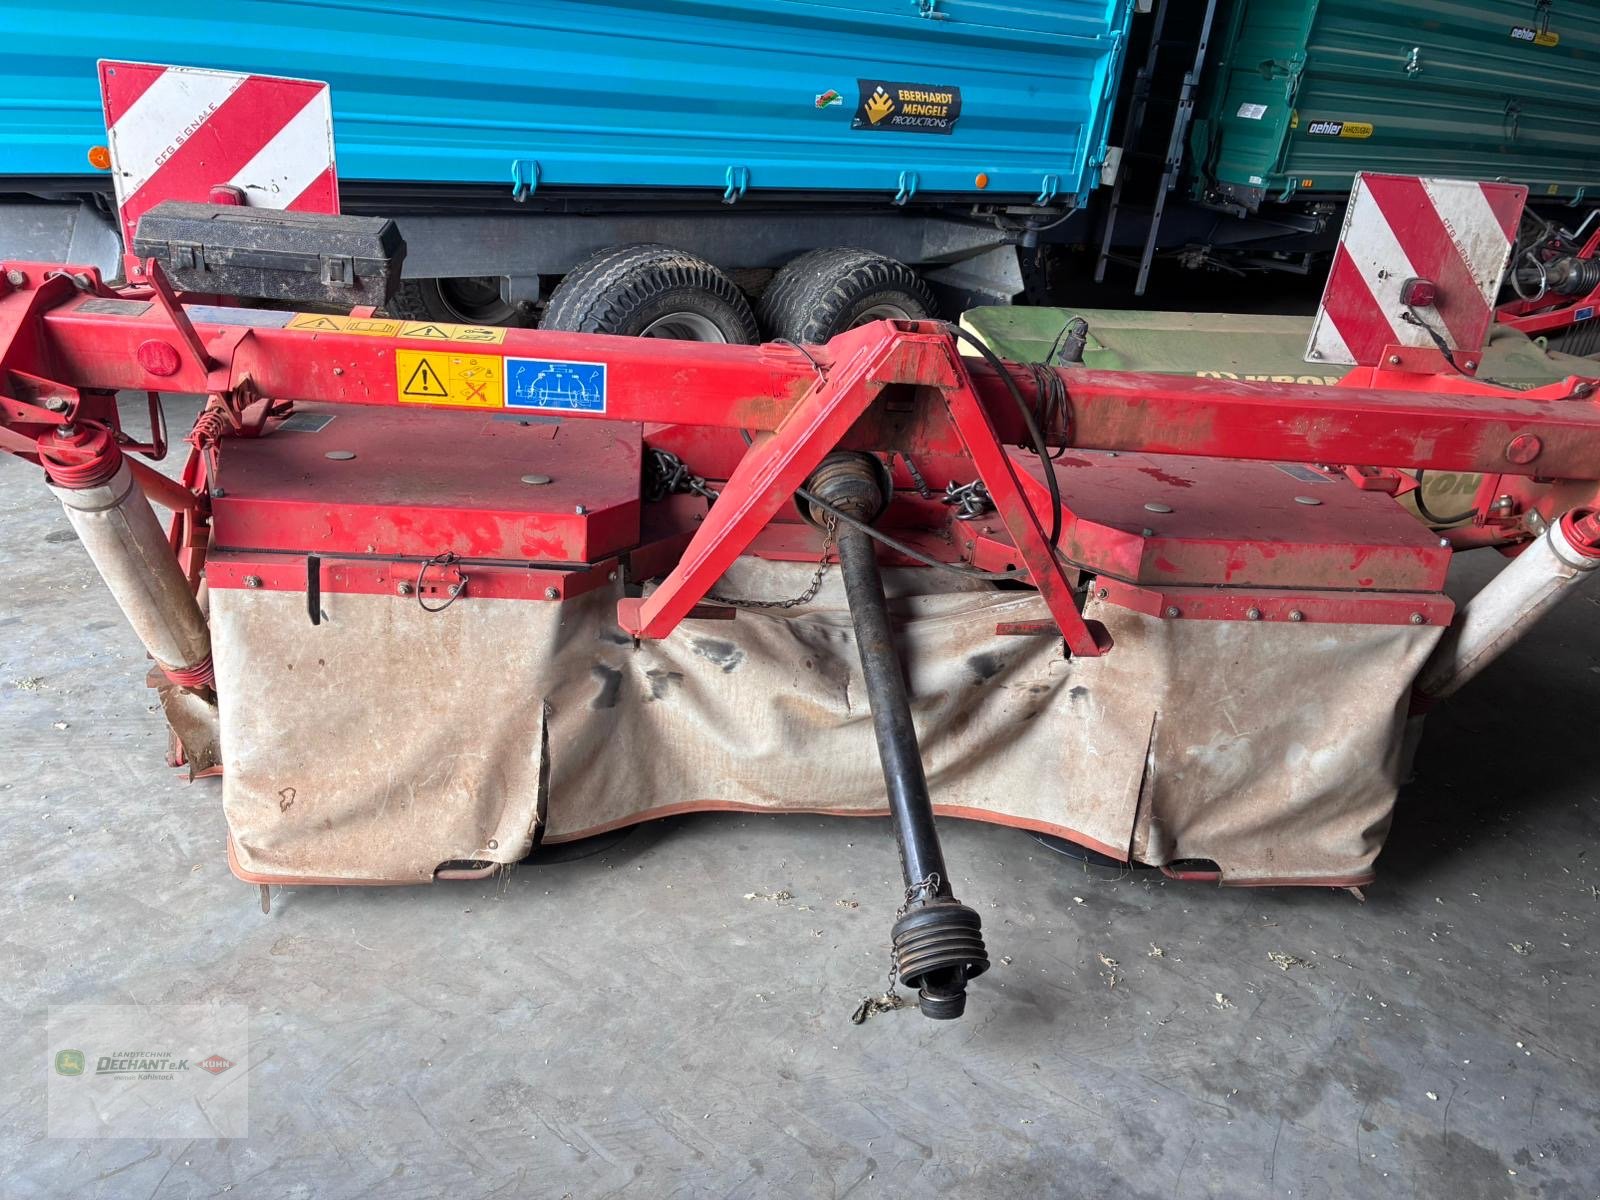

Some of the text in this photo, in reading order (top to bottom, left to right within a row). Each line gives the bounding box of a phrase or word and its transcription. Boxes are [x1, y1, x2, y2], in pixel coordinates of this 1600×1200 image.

[898, 89, 952, 104] EBERHARDT
[902, 103, 948, 117] MENGELE
[891, 115, 948, 128] PRODUCTIONS
[1309, 121, 1342, 135] oehler
[154, 102, 218, 167] CFG SIGNALE
